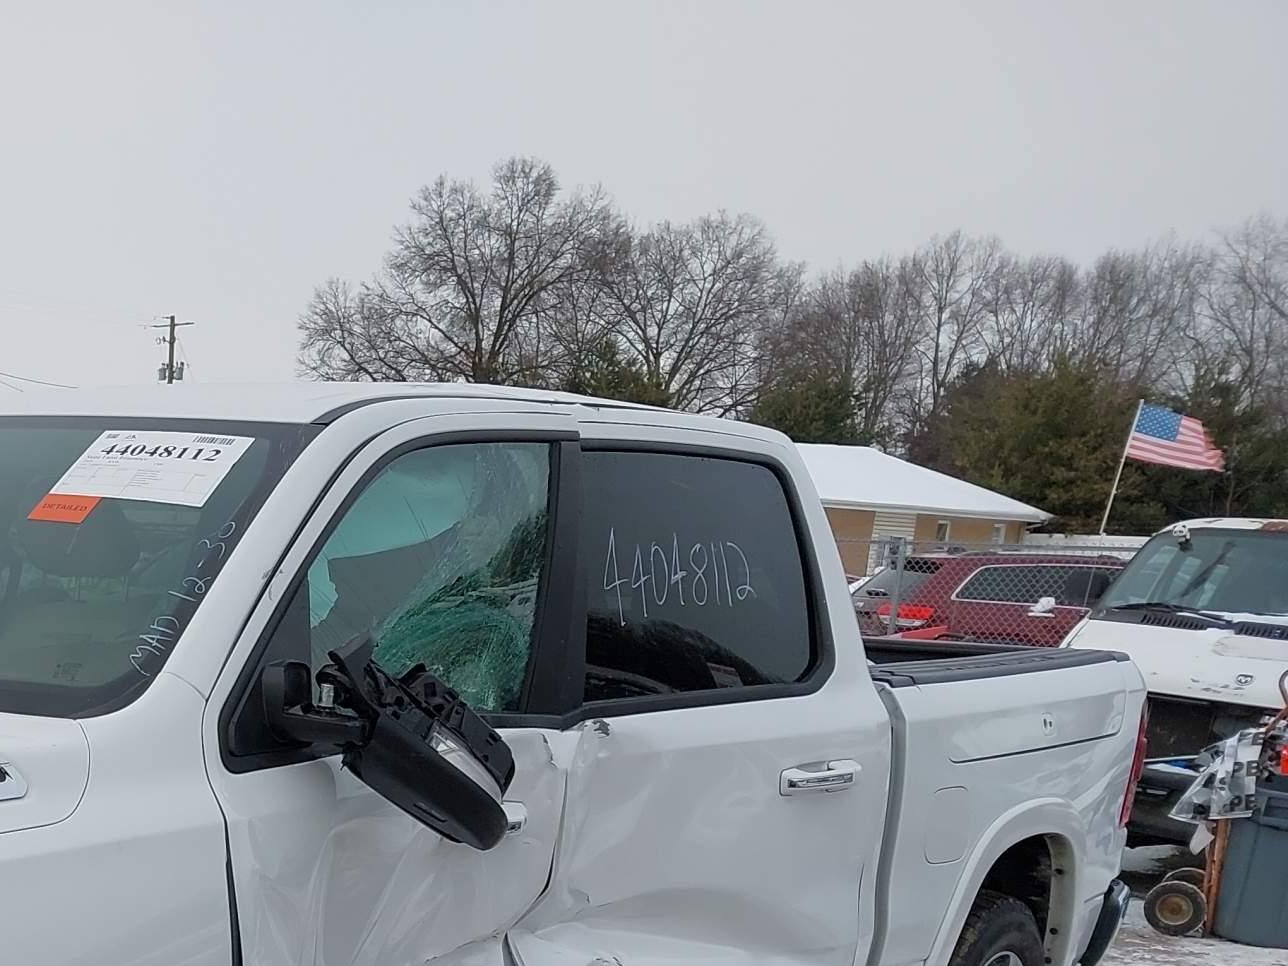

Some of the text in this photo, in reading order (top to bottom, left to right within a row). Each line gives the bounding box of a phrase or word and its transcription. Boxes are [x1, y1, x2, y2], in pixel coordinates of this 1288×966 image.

[100, 443, 222, 462] 44048112
[42, 503, 88, 512] DETAILED
[129, 521, 237, 677] MAD 12-30
[603, 527, 758, 627] 44048112
